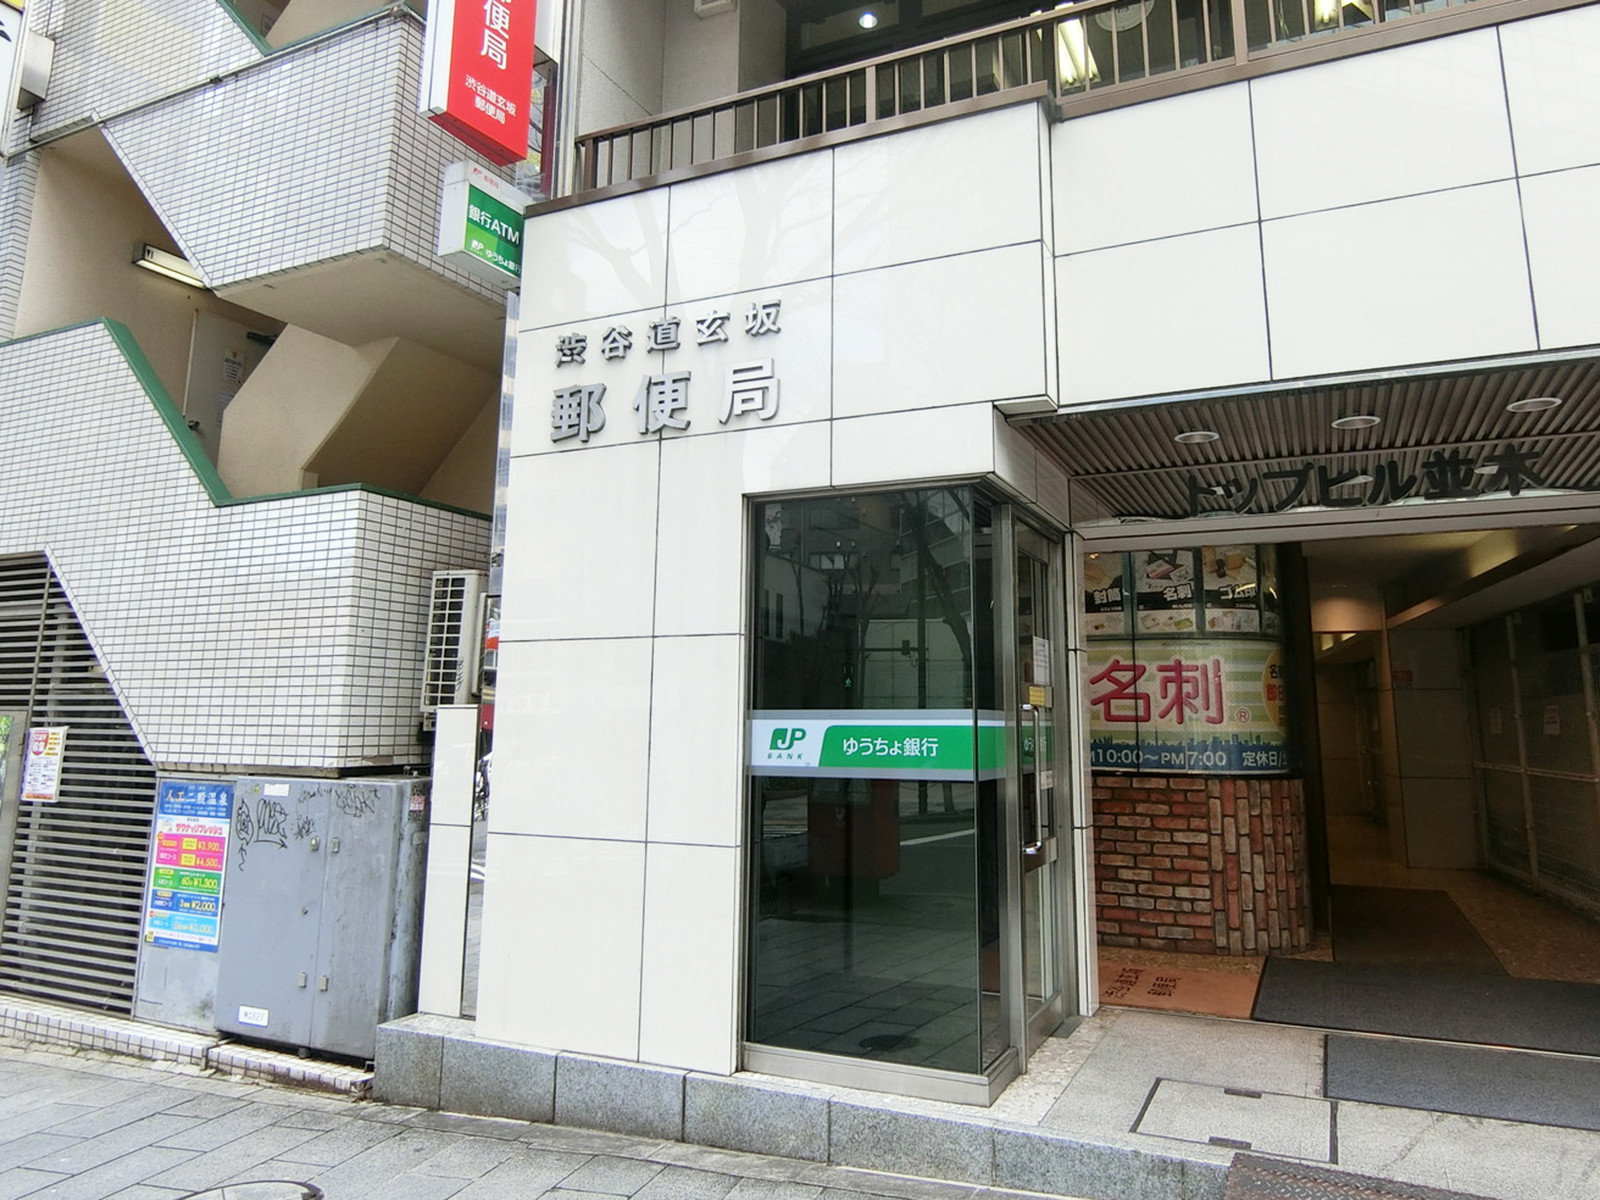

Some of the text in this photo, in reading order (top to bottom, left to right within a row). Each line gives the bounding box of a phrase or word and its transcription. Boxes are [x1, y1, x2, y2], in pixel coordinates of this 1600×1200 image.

[480, 0, 512, 70] 便局
[465, 74, 517, 117] 渋谷道玄坂
[474, 95, 507, 125] 郵便局
[468, 204, 520, 245] 銀行ATM
[555, 299, 782, 367] 渋谷道玄坂
[551, 357, 780, 443] 郵便局
[1163, 582, 1194, 602] 名刺
[1089, 658, 1225, 725] 名刺
[767, 752, 804, 761] BANK
[769, 728, 807, 751] JP
[842, 737, 939, 758] ゆうちょ銀行
